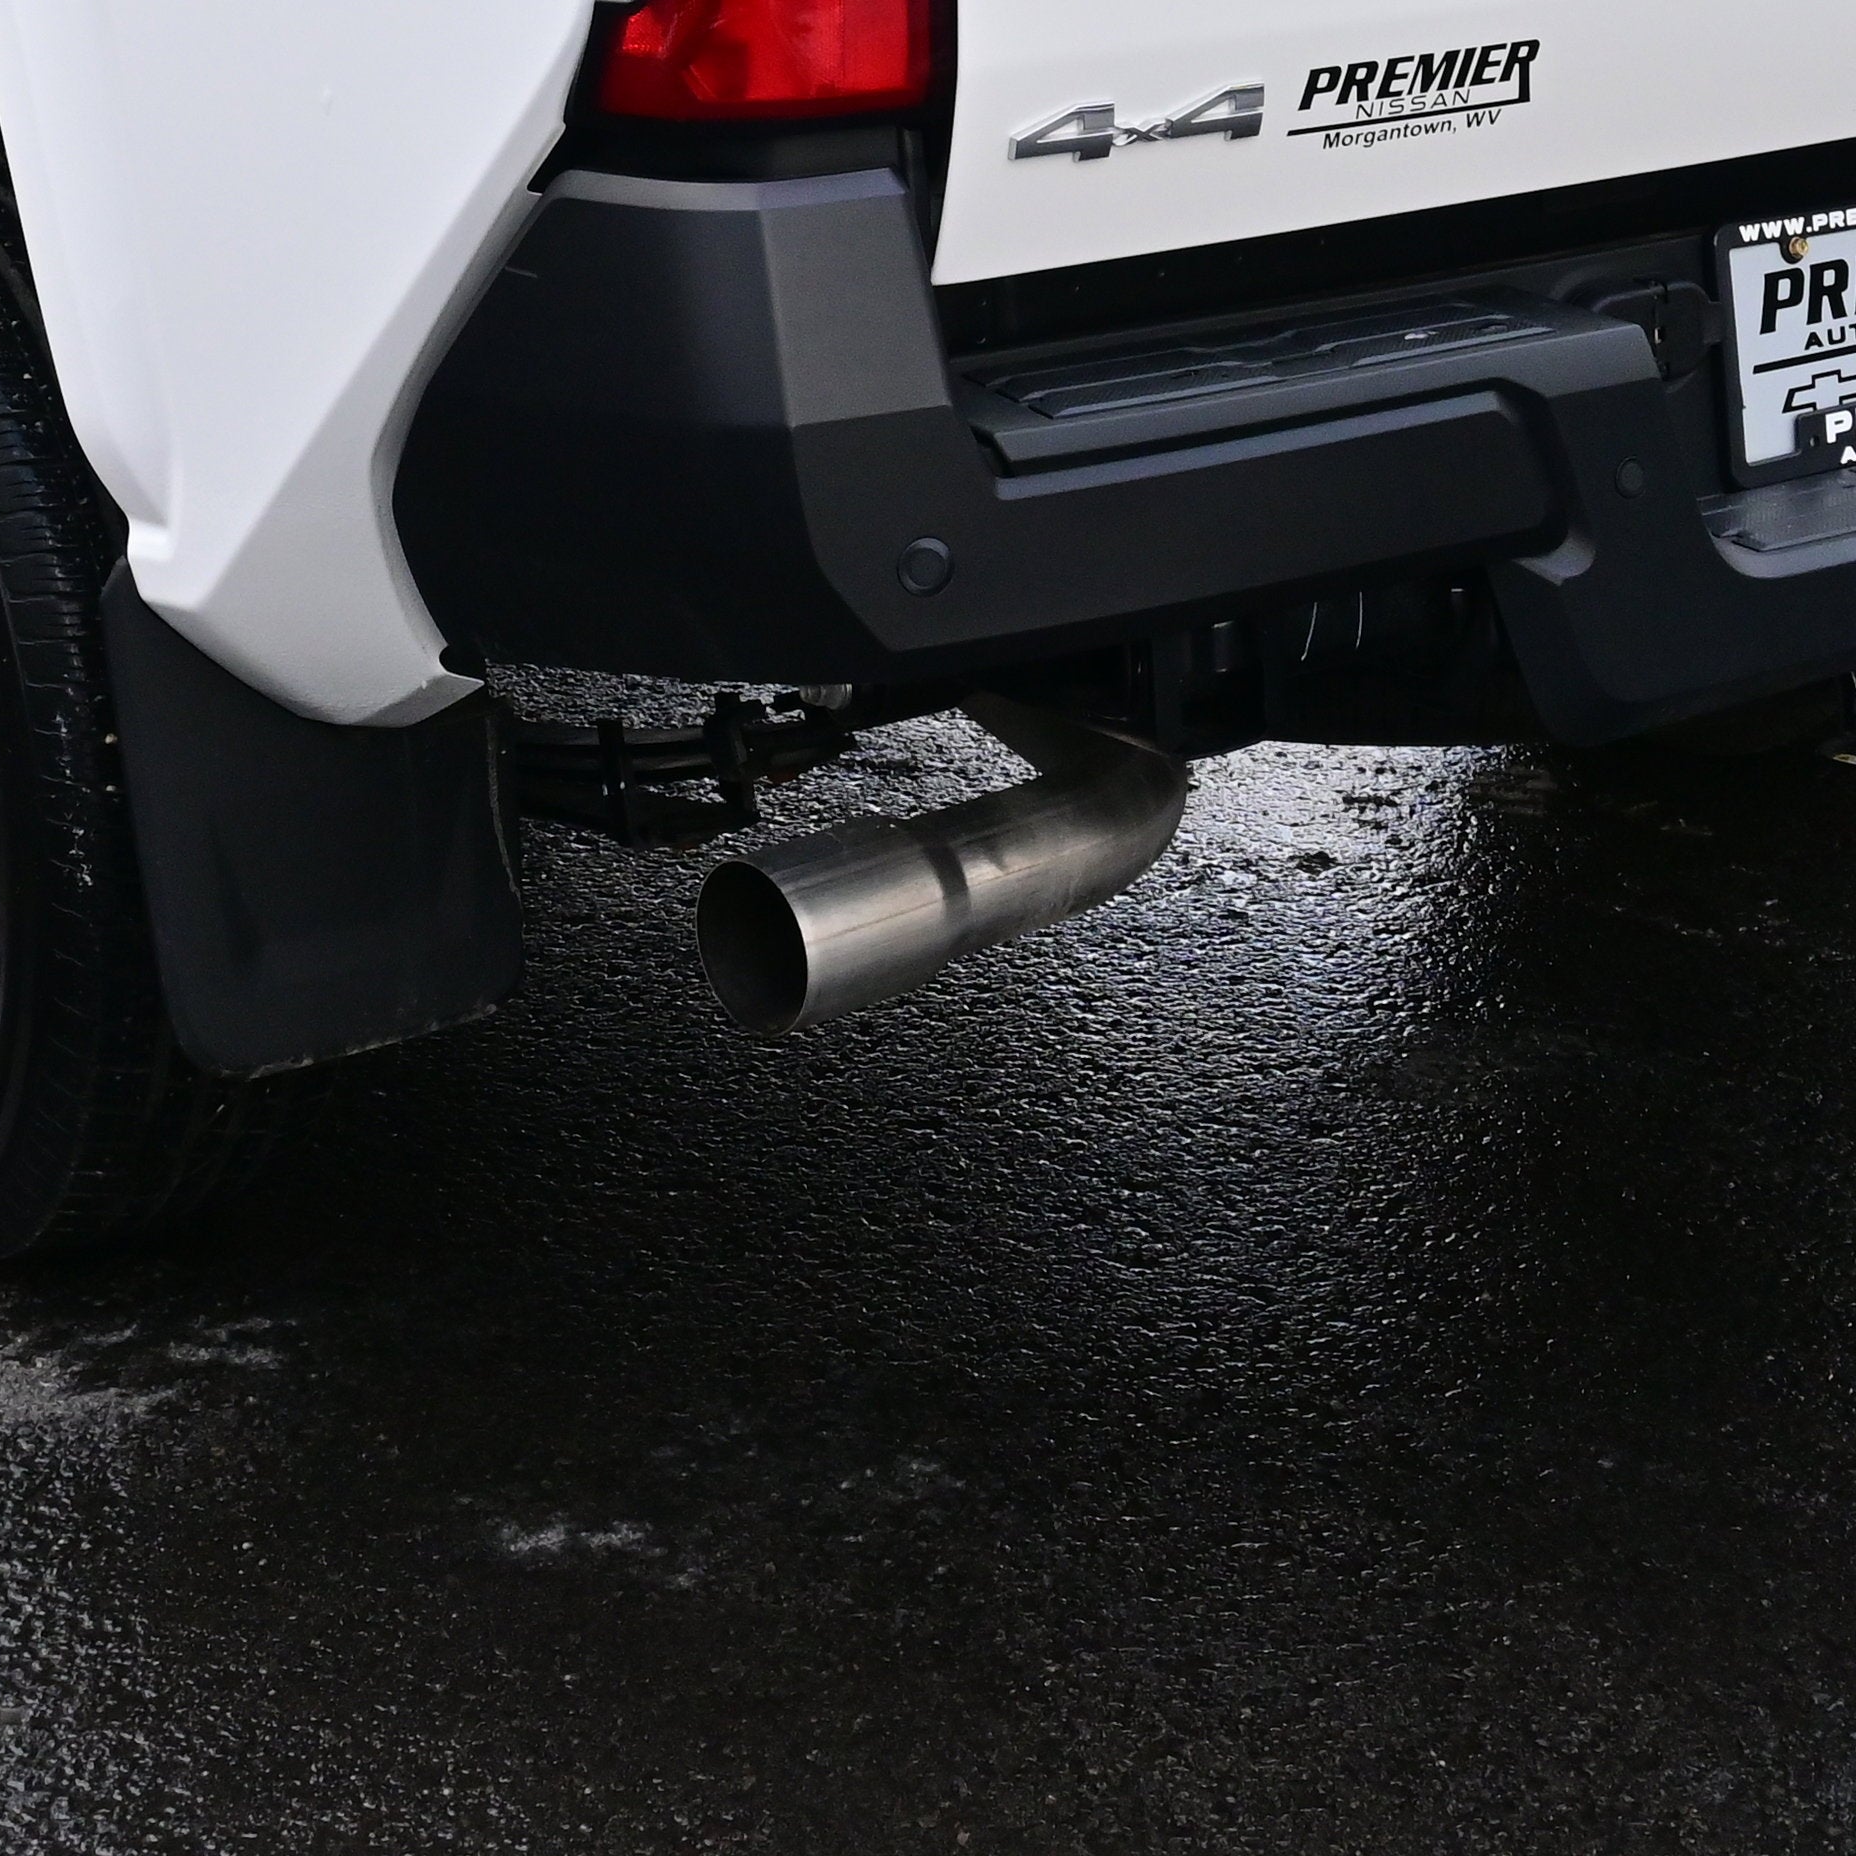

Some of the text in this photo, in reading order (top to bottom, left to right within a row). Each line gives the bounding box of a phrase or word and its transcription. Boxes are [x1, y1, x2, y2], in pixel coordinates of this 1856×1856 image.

[1298, 39, 1541, 111] PREMIER
[1354, 89, 1472, 120] NISSAN
[1322, 108, 1502, 150] Morgantown, WV
